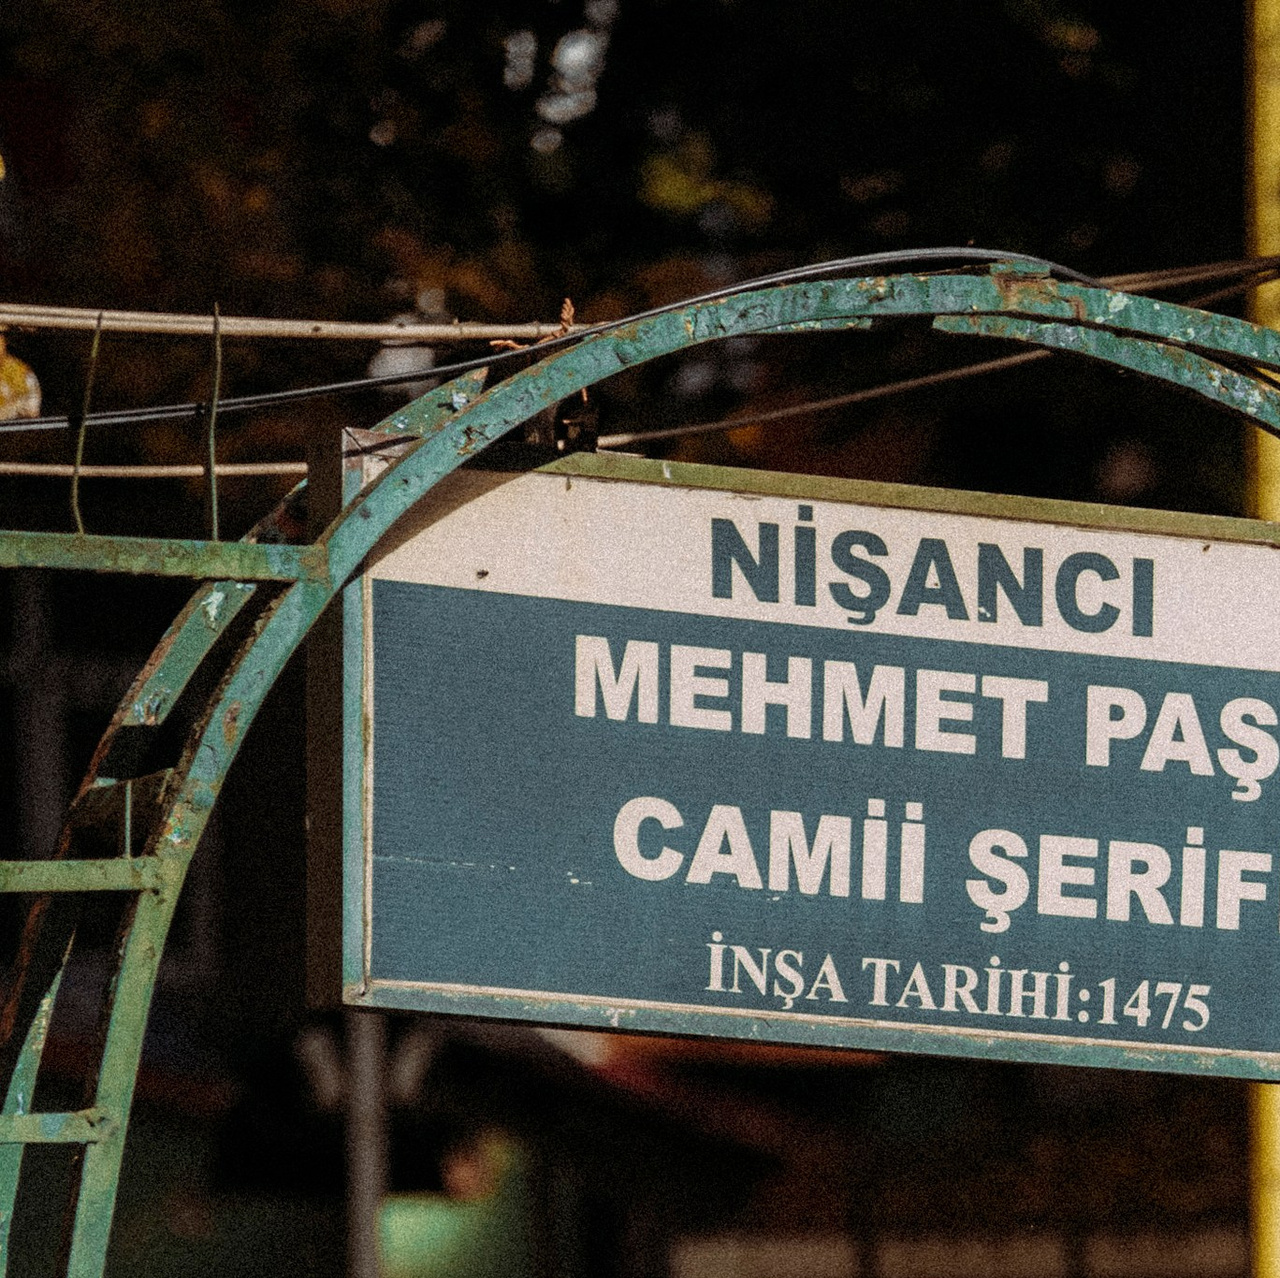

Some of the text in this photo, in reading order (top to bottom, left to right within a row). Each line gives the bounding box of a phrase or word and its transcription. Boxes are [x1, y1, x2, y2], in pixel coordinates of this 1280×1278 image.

[711, 504, 1155, 638] NİŞANCI
[574, 633, 1050, 760] MEHMET
[705, 930, 849, 1012] İNŞA
